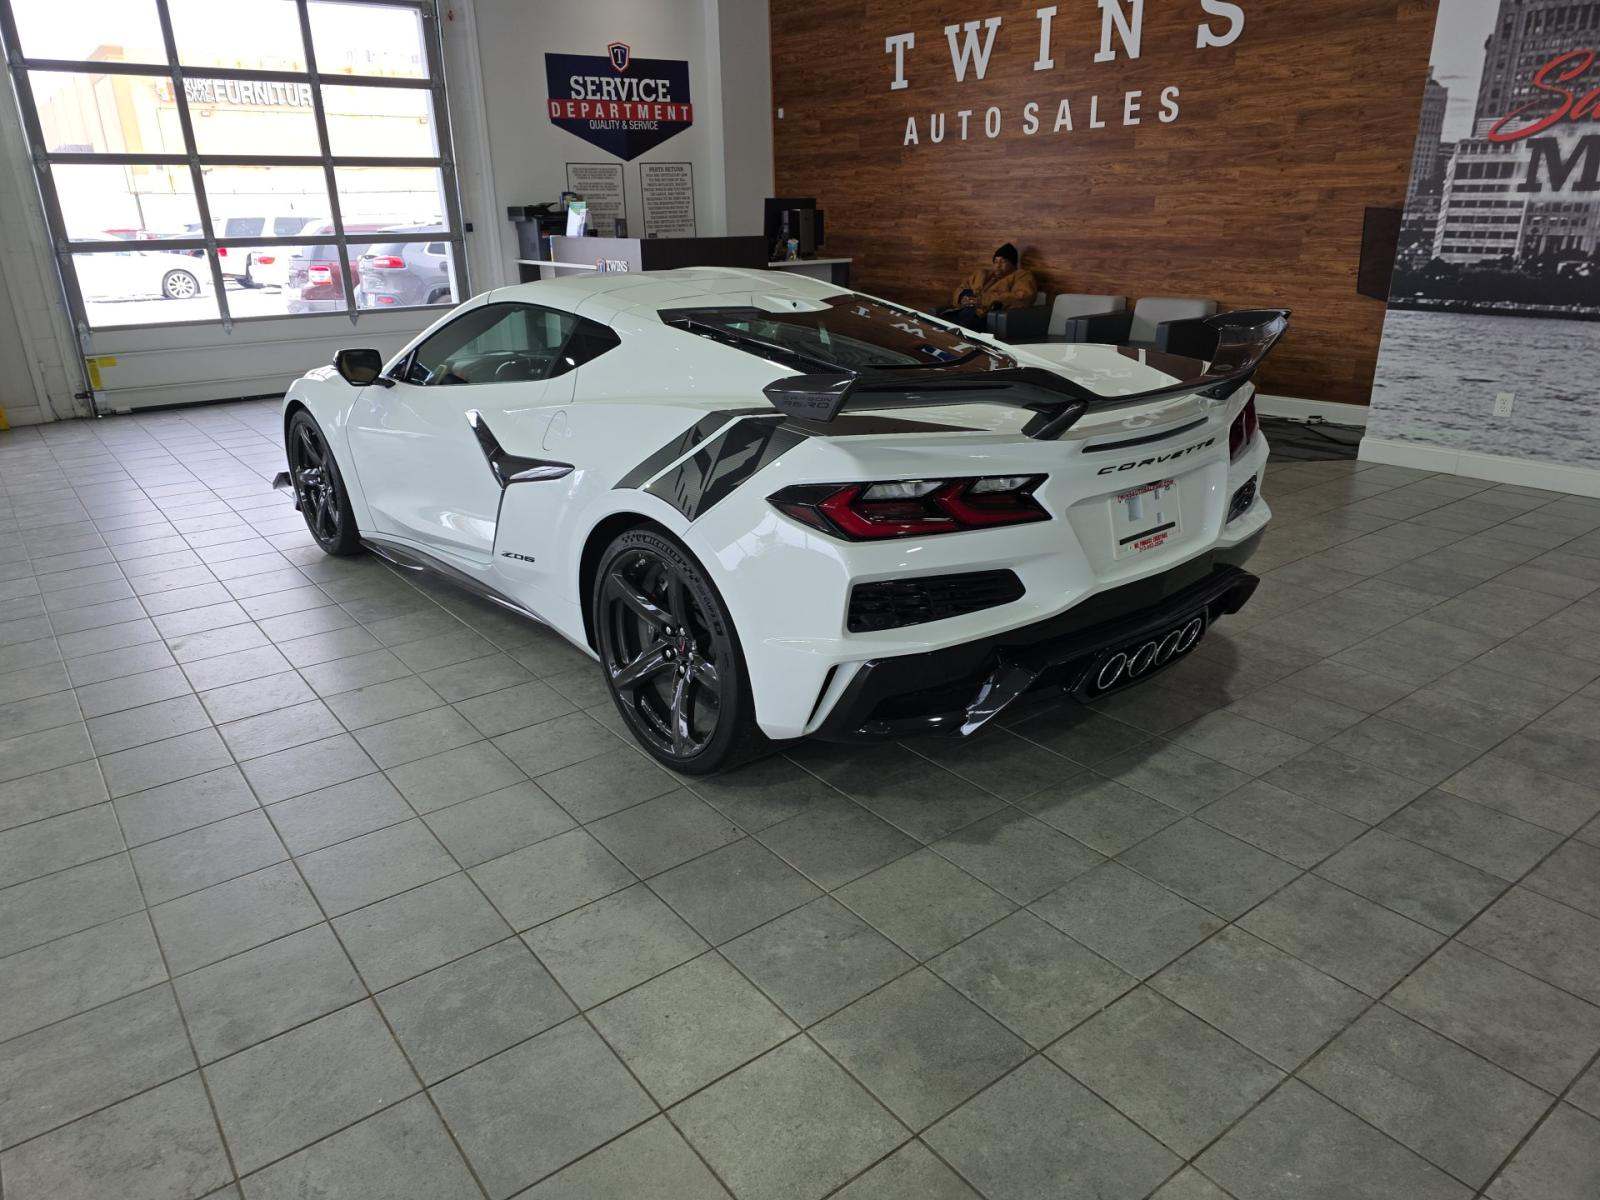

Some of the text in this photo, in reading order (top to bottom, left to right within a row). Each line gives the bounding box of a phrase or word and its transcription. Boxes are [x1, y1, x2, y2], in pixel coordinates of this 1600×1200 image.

[613, 48, 625, 64] T
[885, 0, 1245, 90] TWINS
[213, 79, 314, 108] FURNITUR
[570, 75, 671, 103] SERVICE
[551, 101, 689, 121] DEPARTMENT
[903, 86, 1180, 146] AUTO SALES
[589, 119, 659, 131] QUALITY & SERVICE
[605, 259, 629, 273] TWINS
[1097, 437, 1216, 476] CORVETTE
[501, 552, 536, 563] Z06
